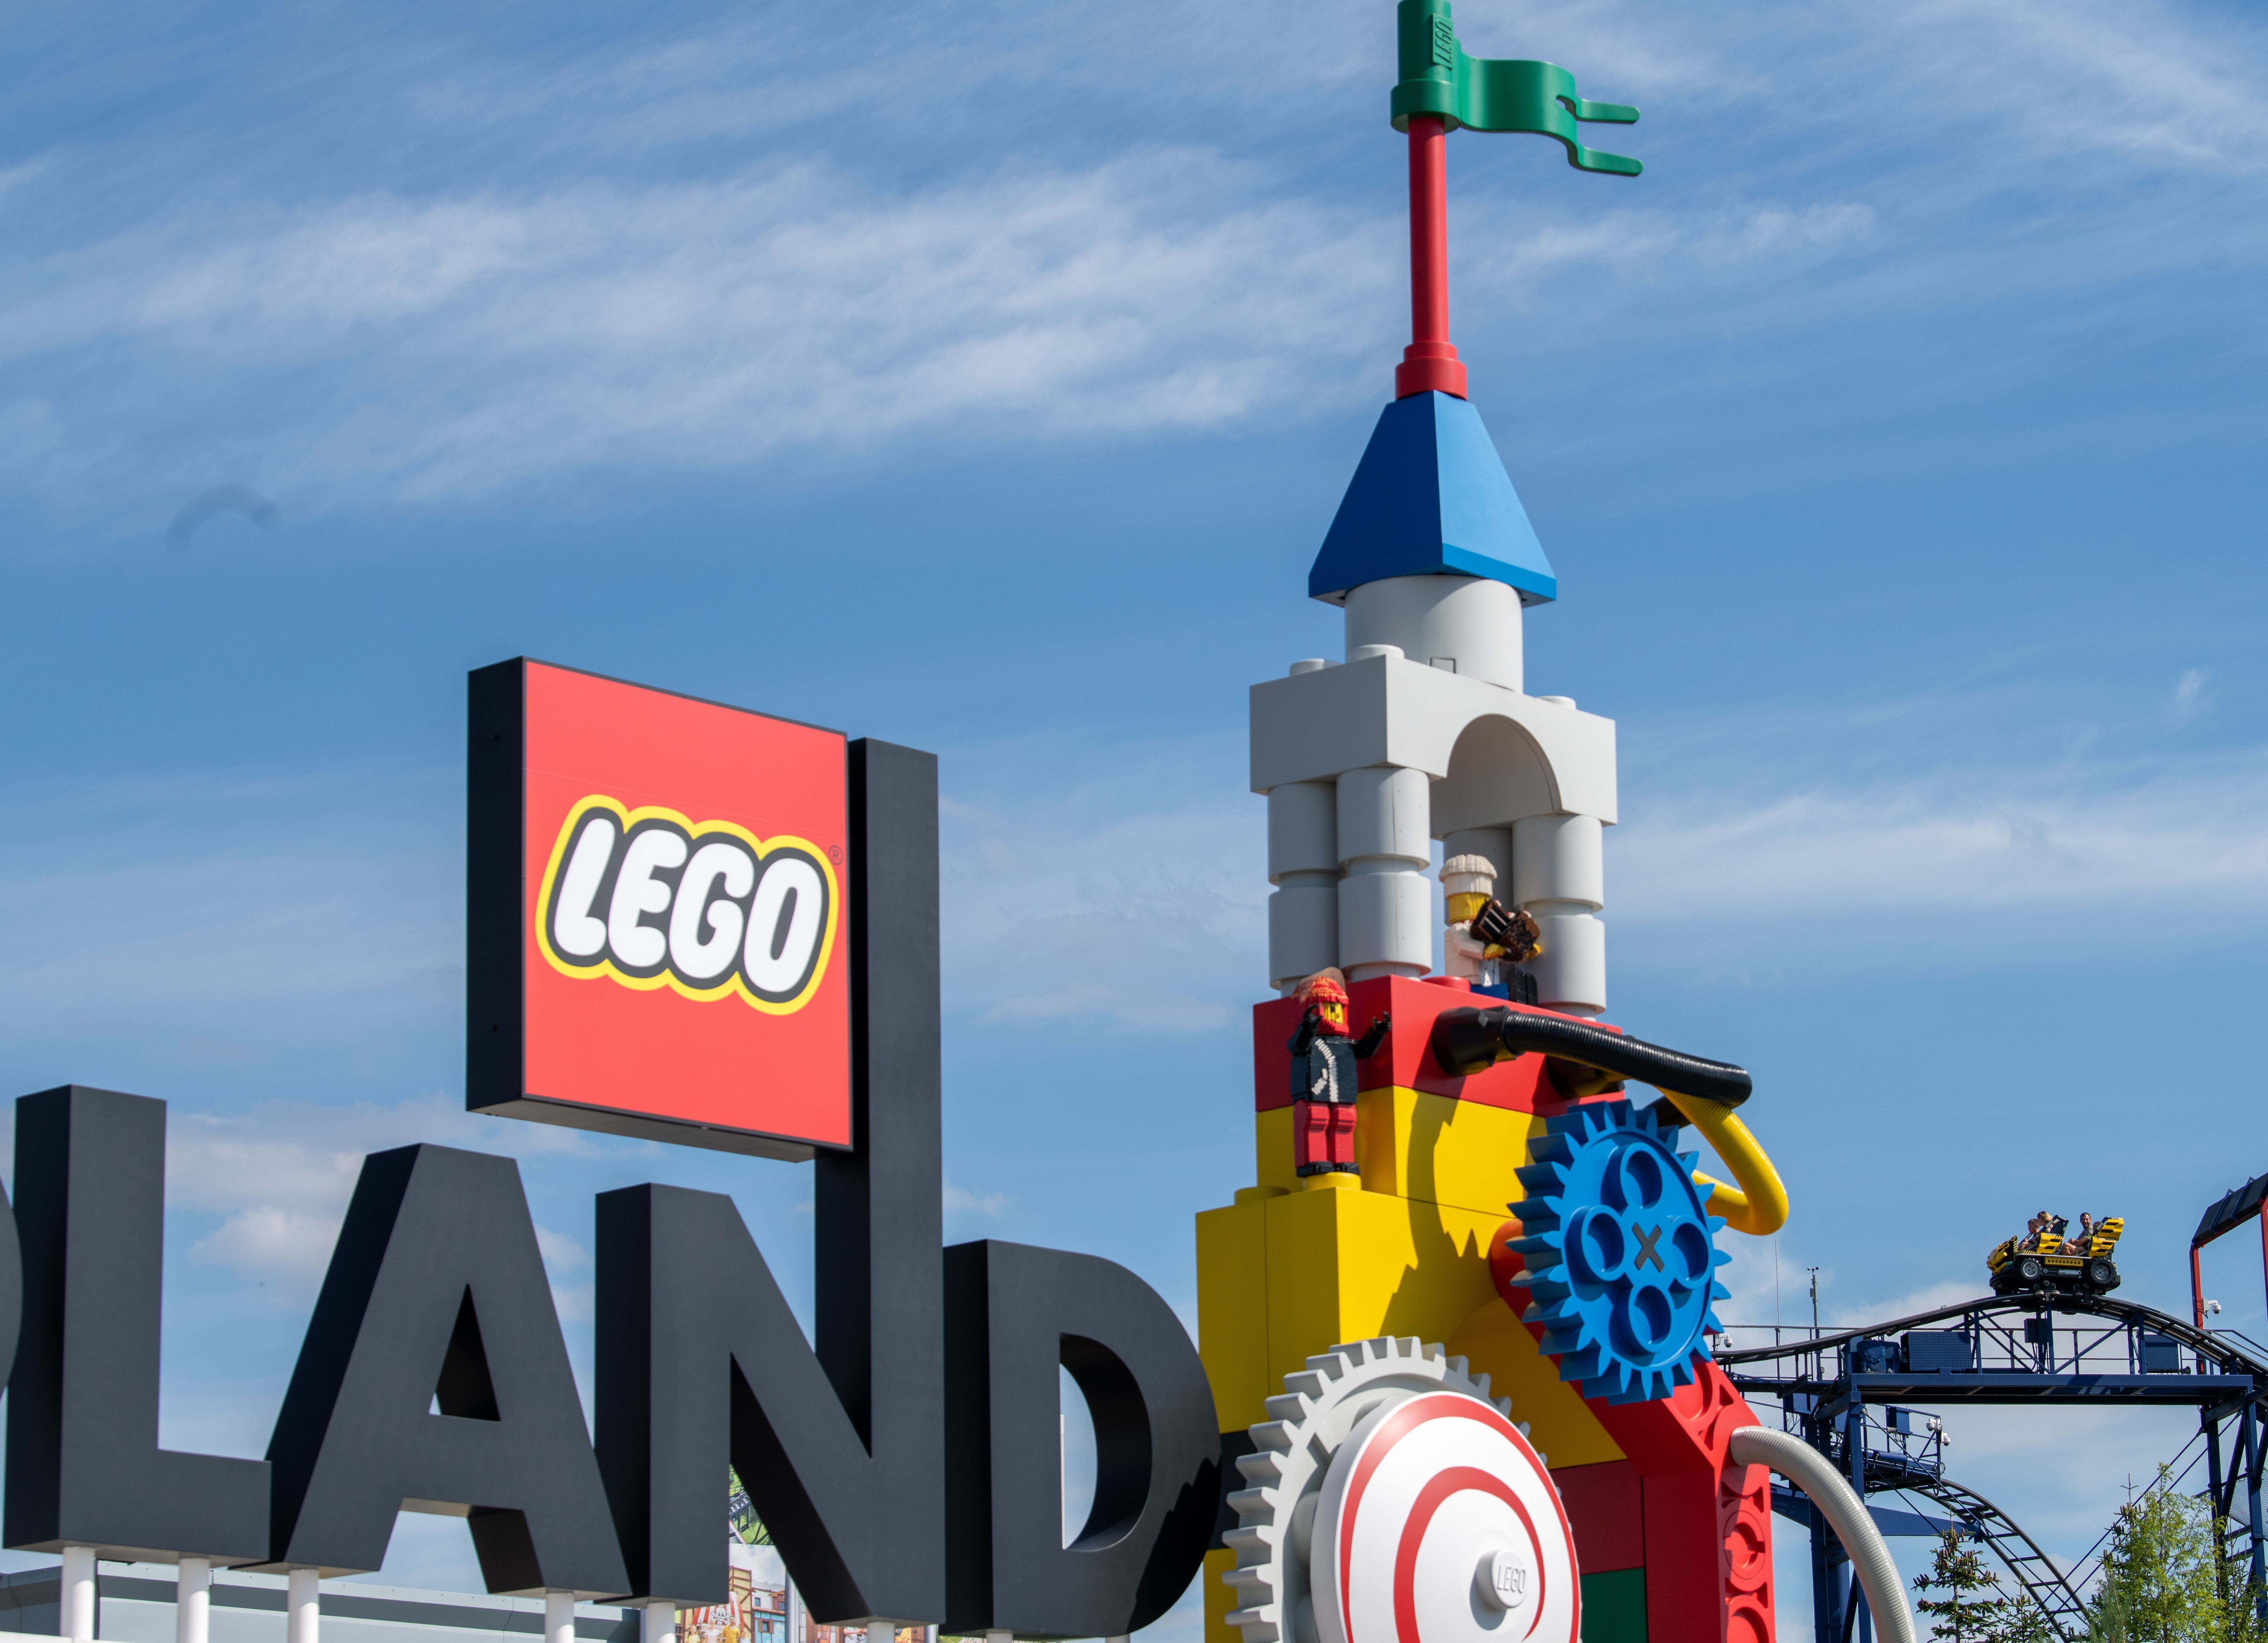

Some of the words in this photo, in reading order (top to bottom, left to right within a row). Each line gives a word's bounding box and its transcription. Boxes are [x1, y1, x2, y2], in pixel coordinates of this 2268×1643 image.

[1435, 19, 1452, 63] LEGO
[546, 806, 832, 1004] LEGO
[0, 738, 1222, 1638] LAND
[1497, 1564, 1526, 1593] LEGO
